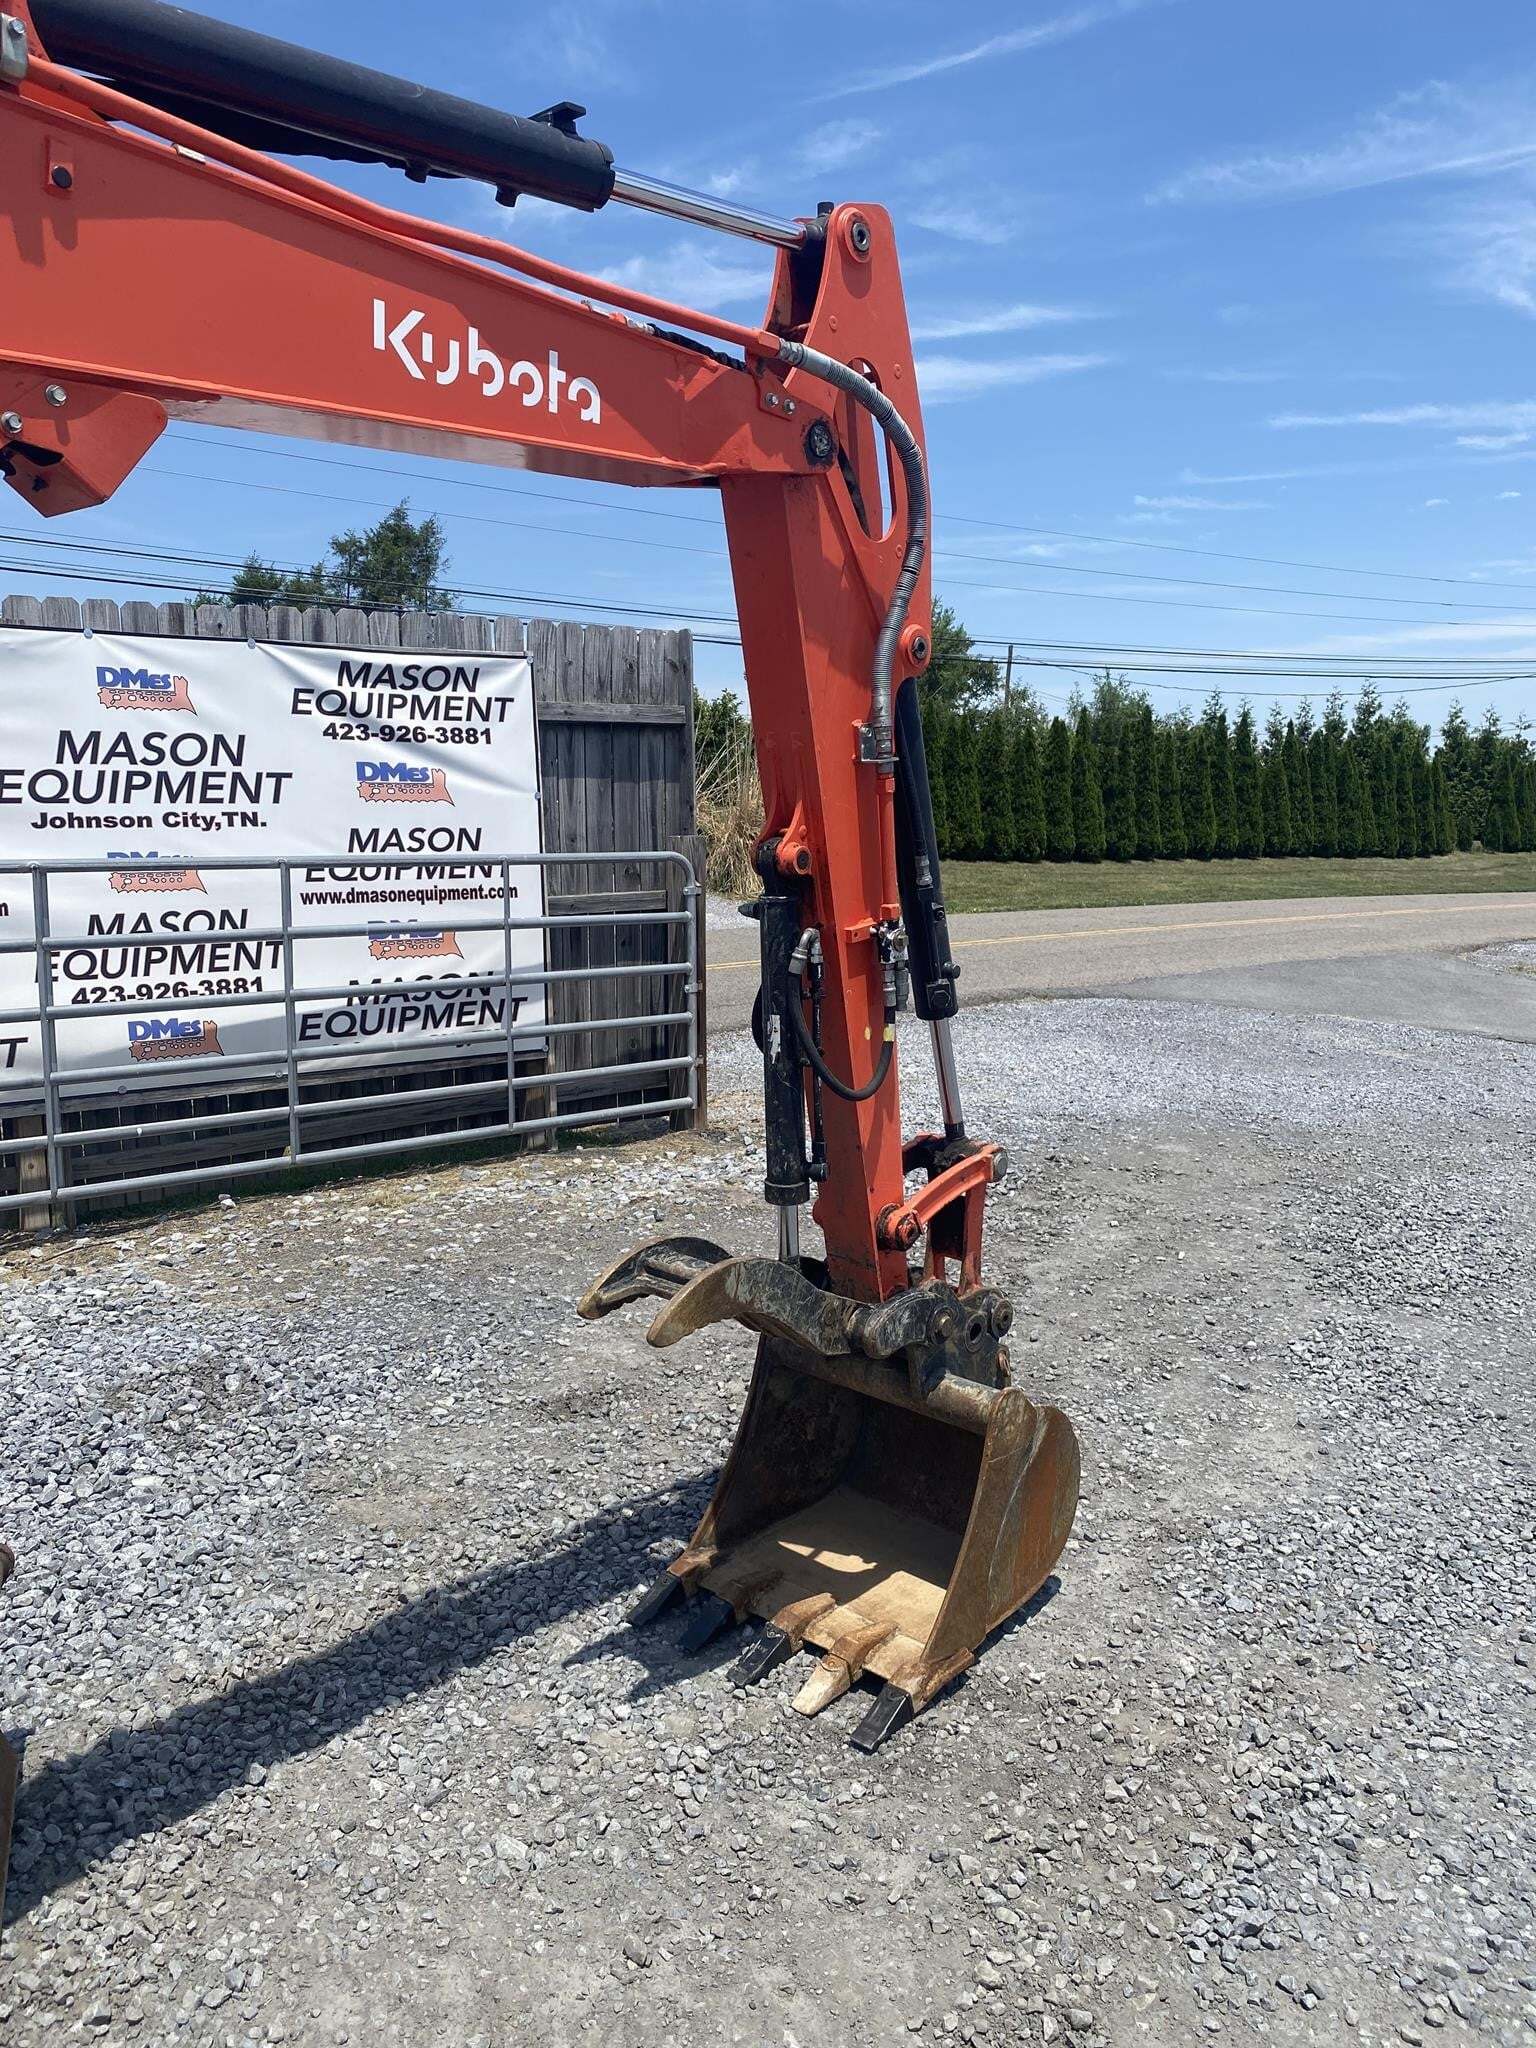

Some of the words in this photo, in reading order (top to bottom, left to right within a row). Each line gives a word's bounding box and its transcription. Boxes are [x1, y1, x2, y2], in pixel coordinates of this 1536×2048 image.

[374, 298, 601, 425] Kubota
[337, 660, 480, 692] MASON
[291, 687, 514, 723] EQUIPMENT
[322, 722, 492, 745] 423-926-3881
[55, 730, 246, 767] MASON
[0, 769, 293, 804] EQUIPMENT
[31, 812, 153, 829] Johnson
[347, 827, 482, 853] MASON
[305, 863, 505, 882] EQUIPMEN
[300, 884, 518, 905] www.dmasonequipment.com
[87, 908, 248, 936] MASON
[71, 976, 263, 1005] 423-926-3881
[298, 996, 528, 1042] EQUIPMENT
